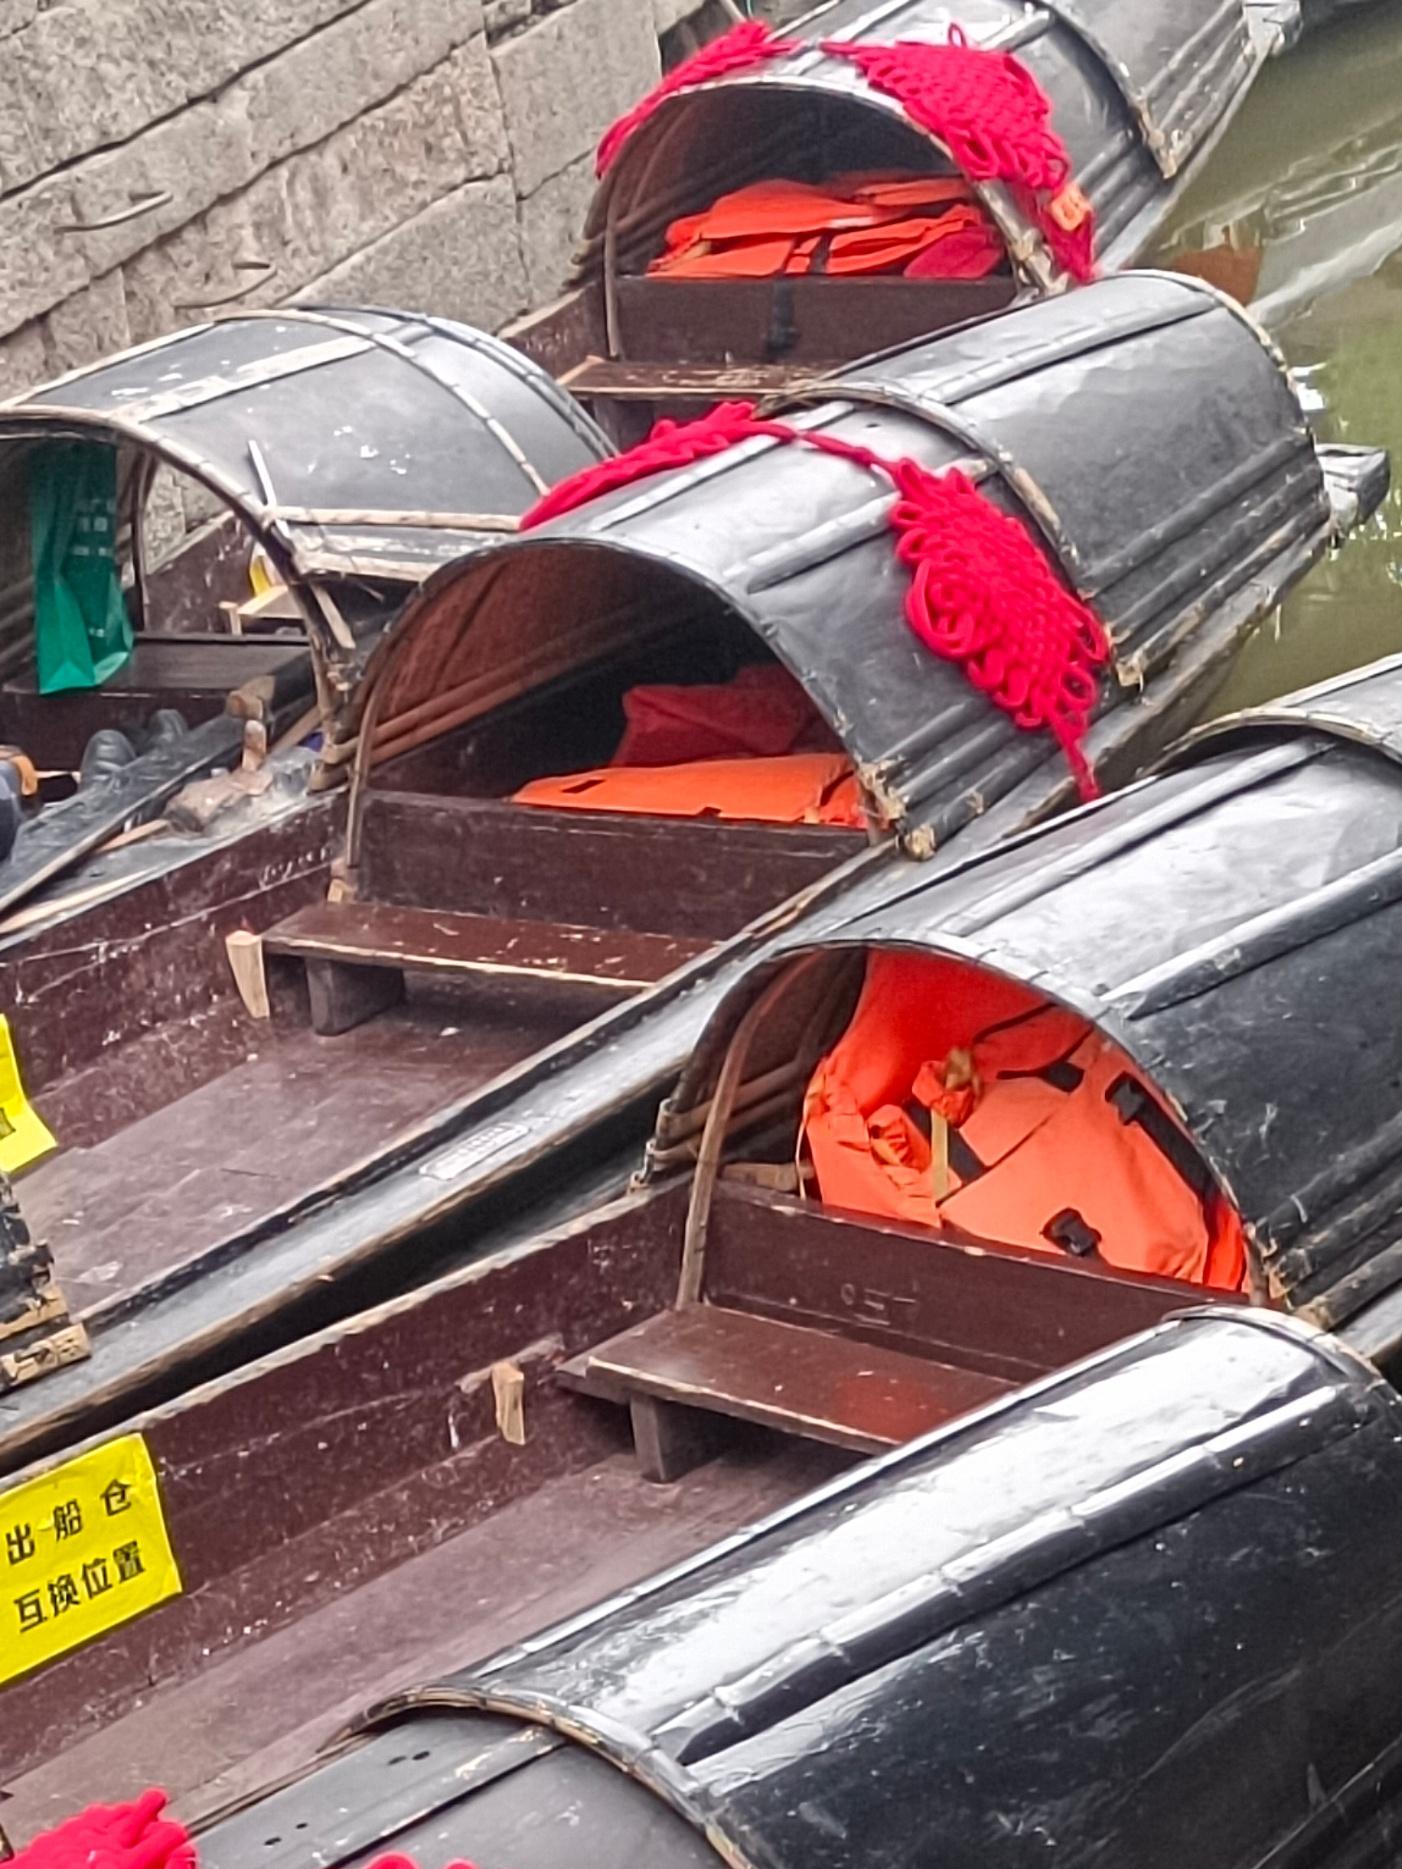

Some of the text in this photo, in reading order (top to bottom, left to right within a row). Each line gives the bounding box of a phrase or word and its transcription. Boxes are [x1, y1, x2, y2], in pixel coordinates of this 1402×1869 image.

[5, 1478, 132, 1566] 出船仓
[13, 1540, 146, 1633] 互换位置
